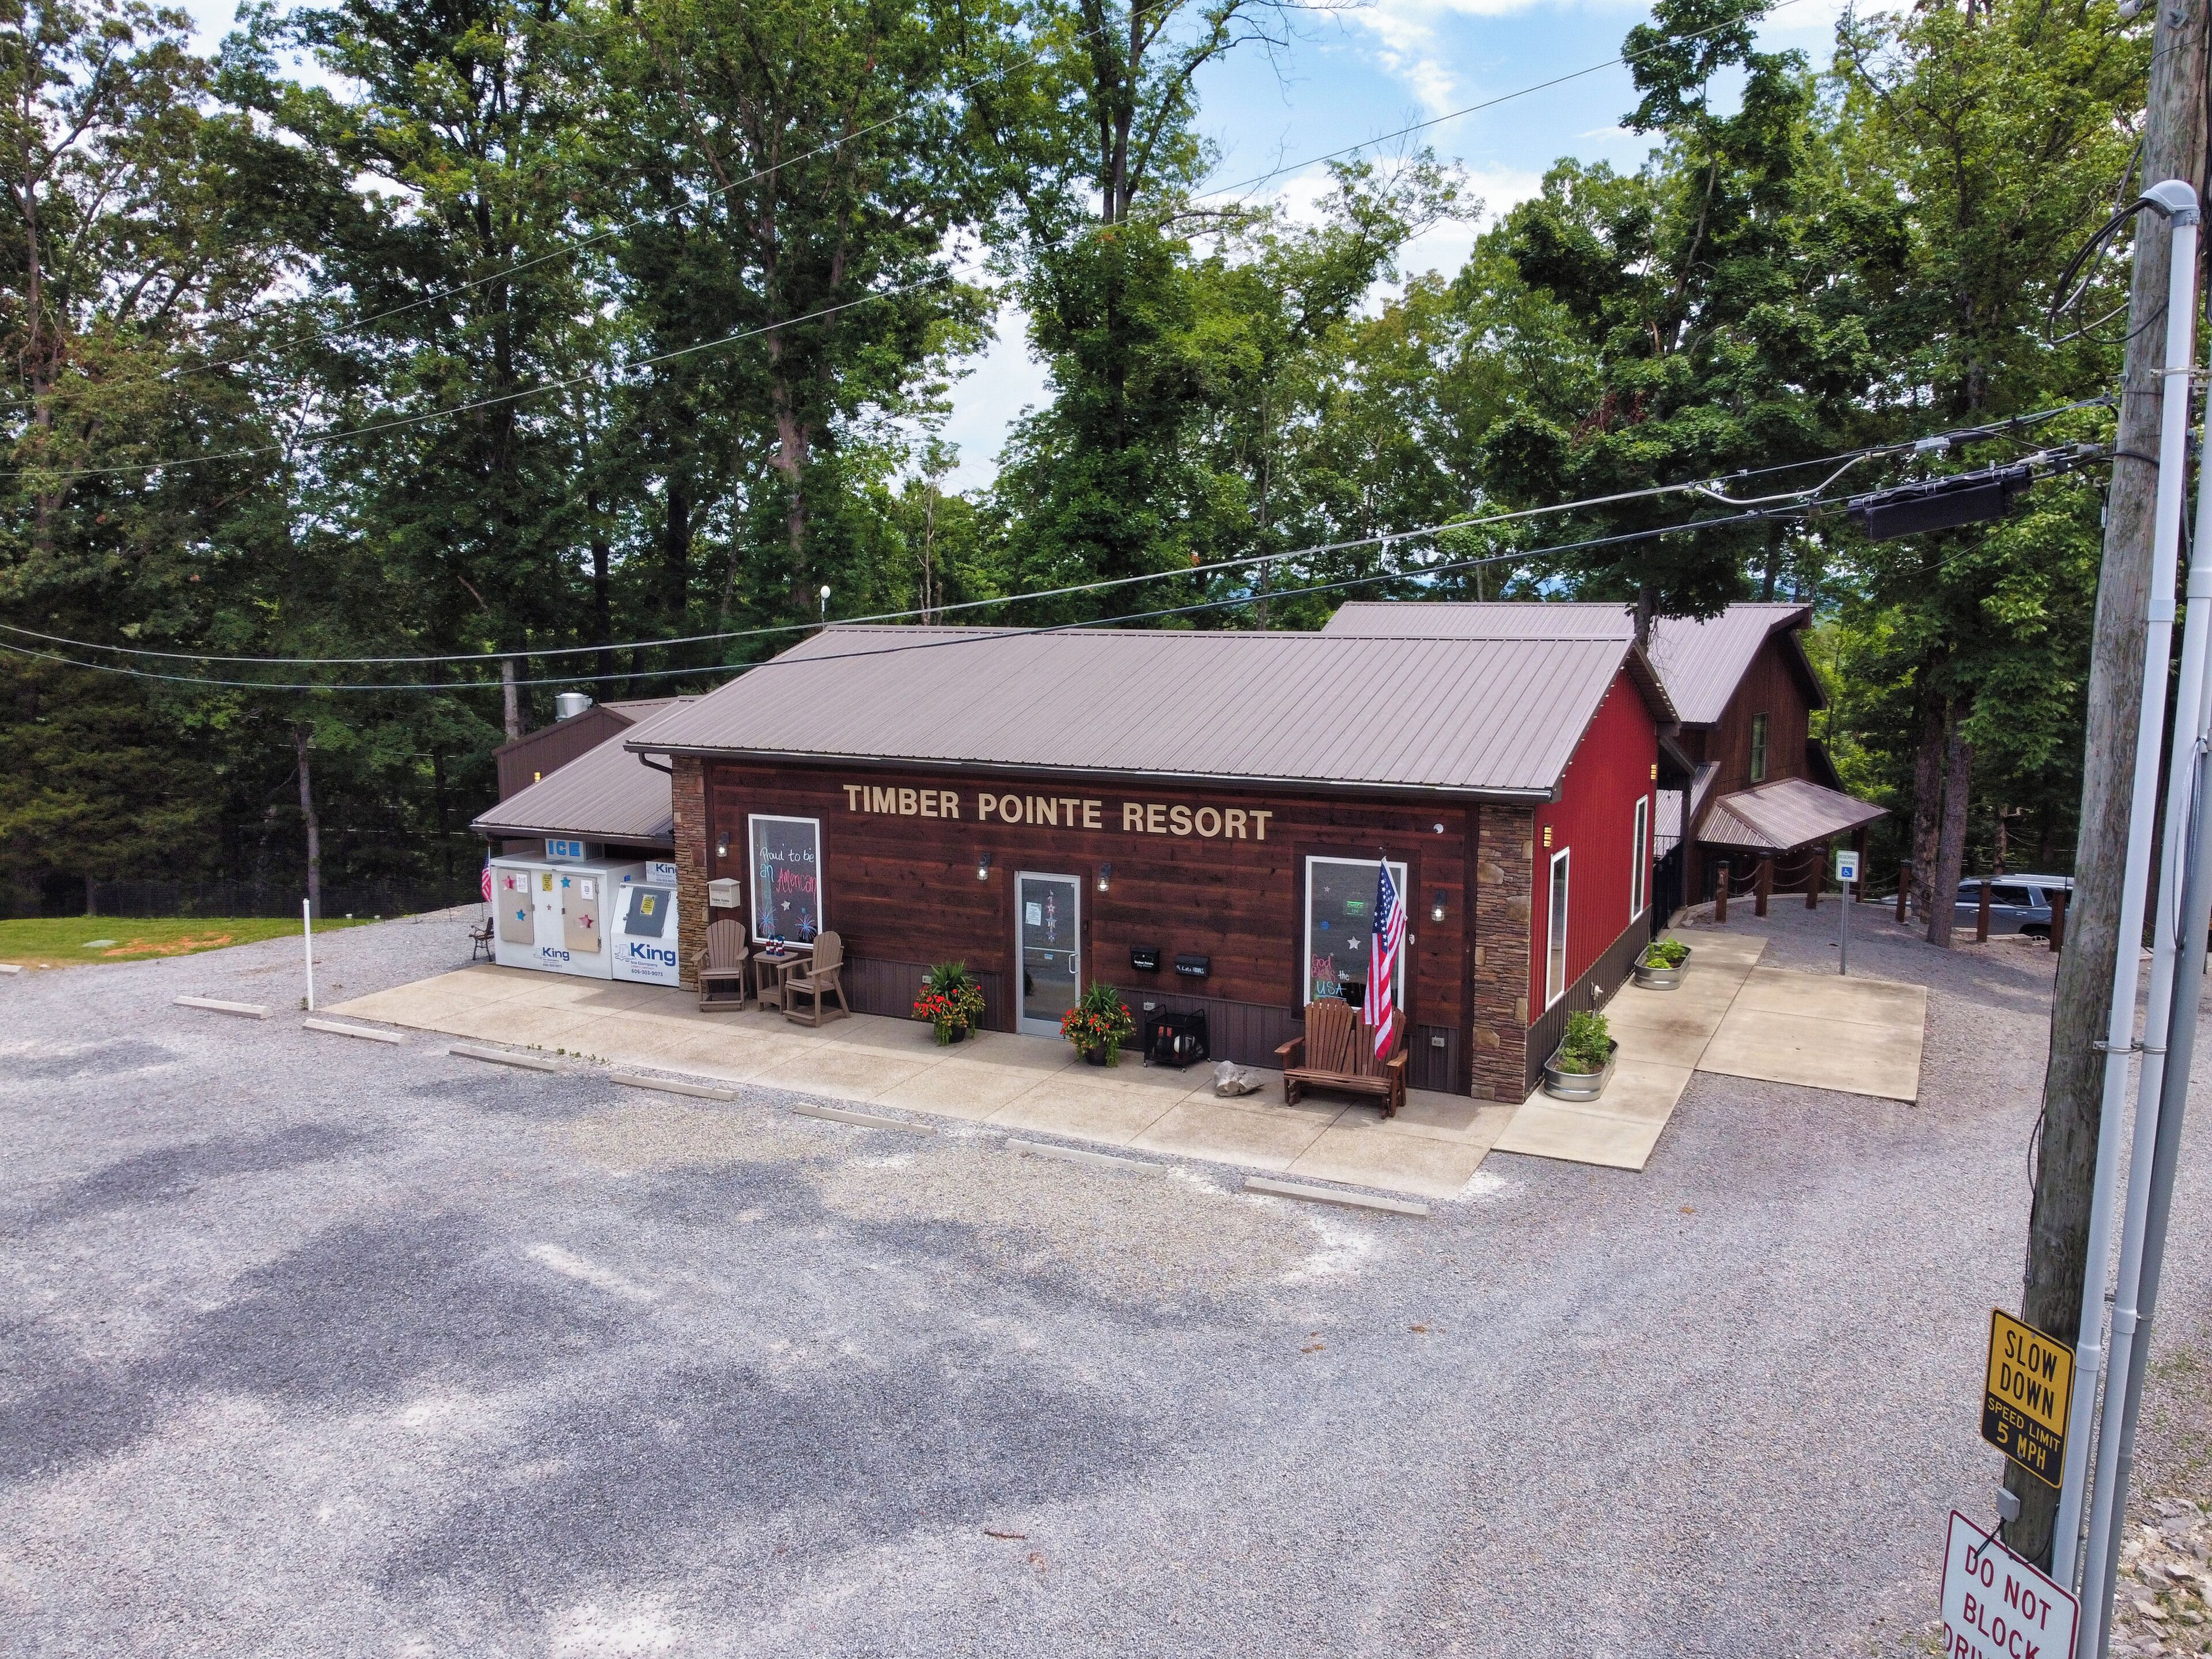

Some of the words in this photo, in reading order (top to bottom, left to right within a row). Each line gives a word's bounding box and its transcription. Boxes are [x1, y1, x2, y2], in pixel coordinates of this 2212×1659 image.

[843, 785, 959, 819] TIMBER
[979, 793, 1102, 828] POINTE
[1123, 802, 1272, 840] RESORT
[548, 840, 581, 857] ICE
[760, 847, 785, 862] Proud
[788, 849, 800, 862] to
[803, 849, 815, 862] be
[656, 863, 677, 874] Kin
[760, 863, 774, 882] an
[543, 946, 570, 961] King
[630, 942, 676, 967] King
[1312, 953, 1331, 968] God
[631, 968, 663, 976] 606-303-9073
[1338, 969, 1350, 981] the
[1316, 981, 1347, 996] USA
[2005, 1330, 2058, 1382] SLOW
[1999, 1362, 2055, 1420] DOWN
[1987, 1397, 2024, 1429] SPEED
[2029, 1423, 2061, 1452] LIMIT
[1997, 1421, 2009, 1444] 5
[2017, 1434, 2046, 1470] MPH
[1965, 1544, 1994, 1588] DO
[2003, 1574, 2052, 1630] NOT
[1963, 1592, 2040, 1659] BLOCK
